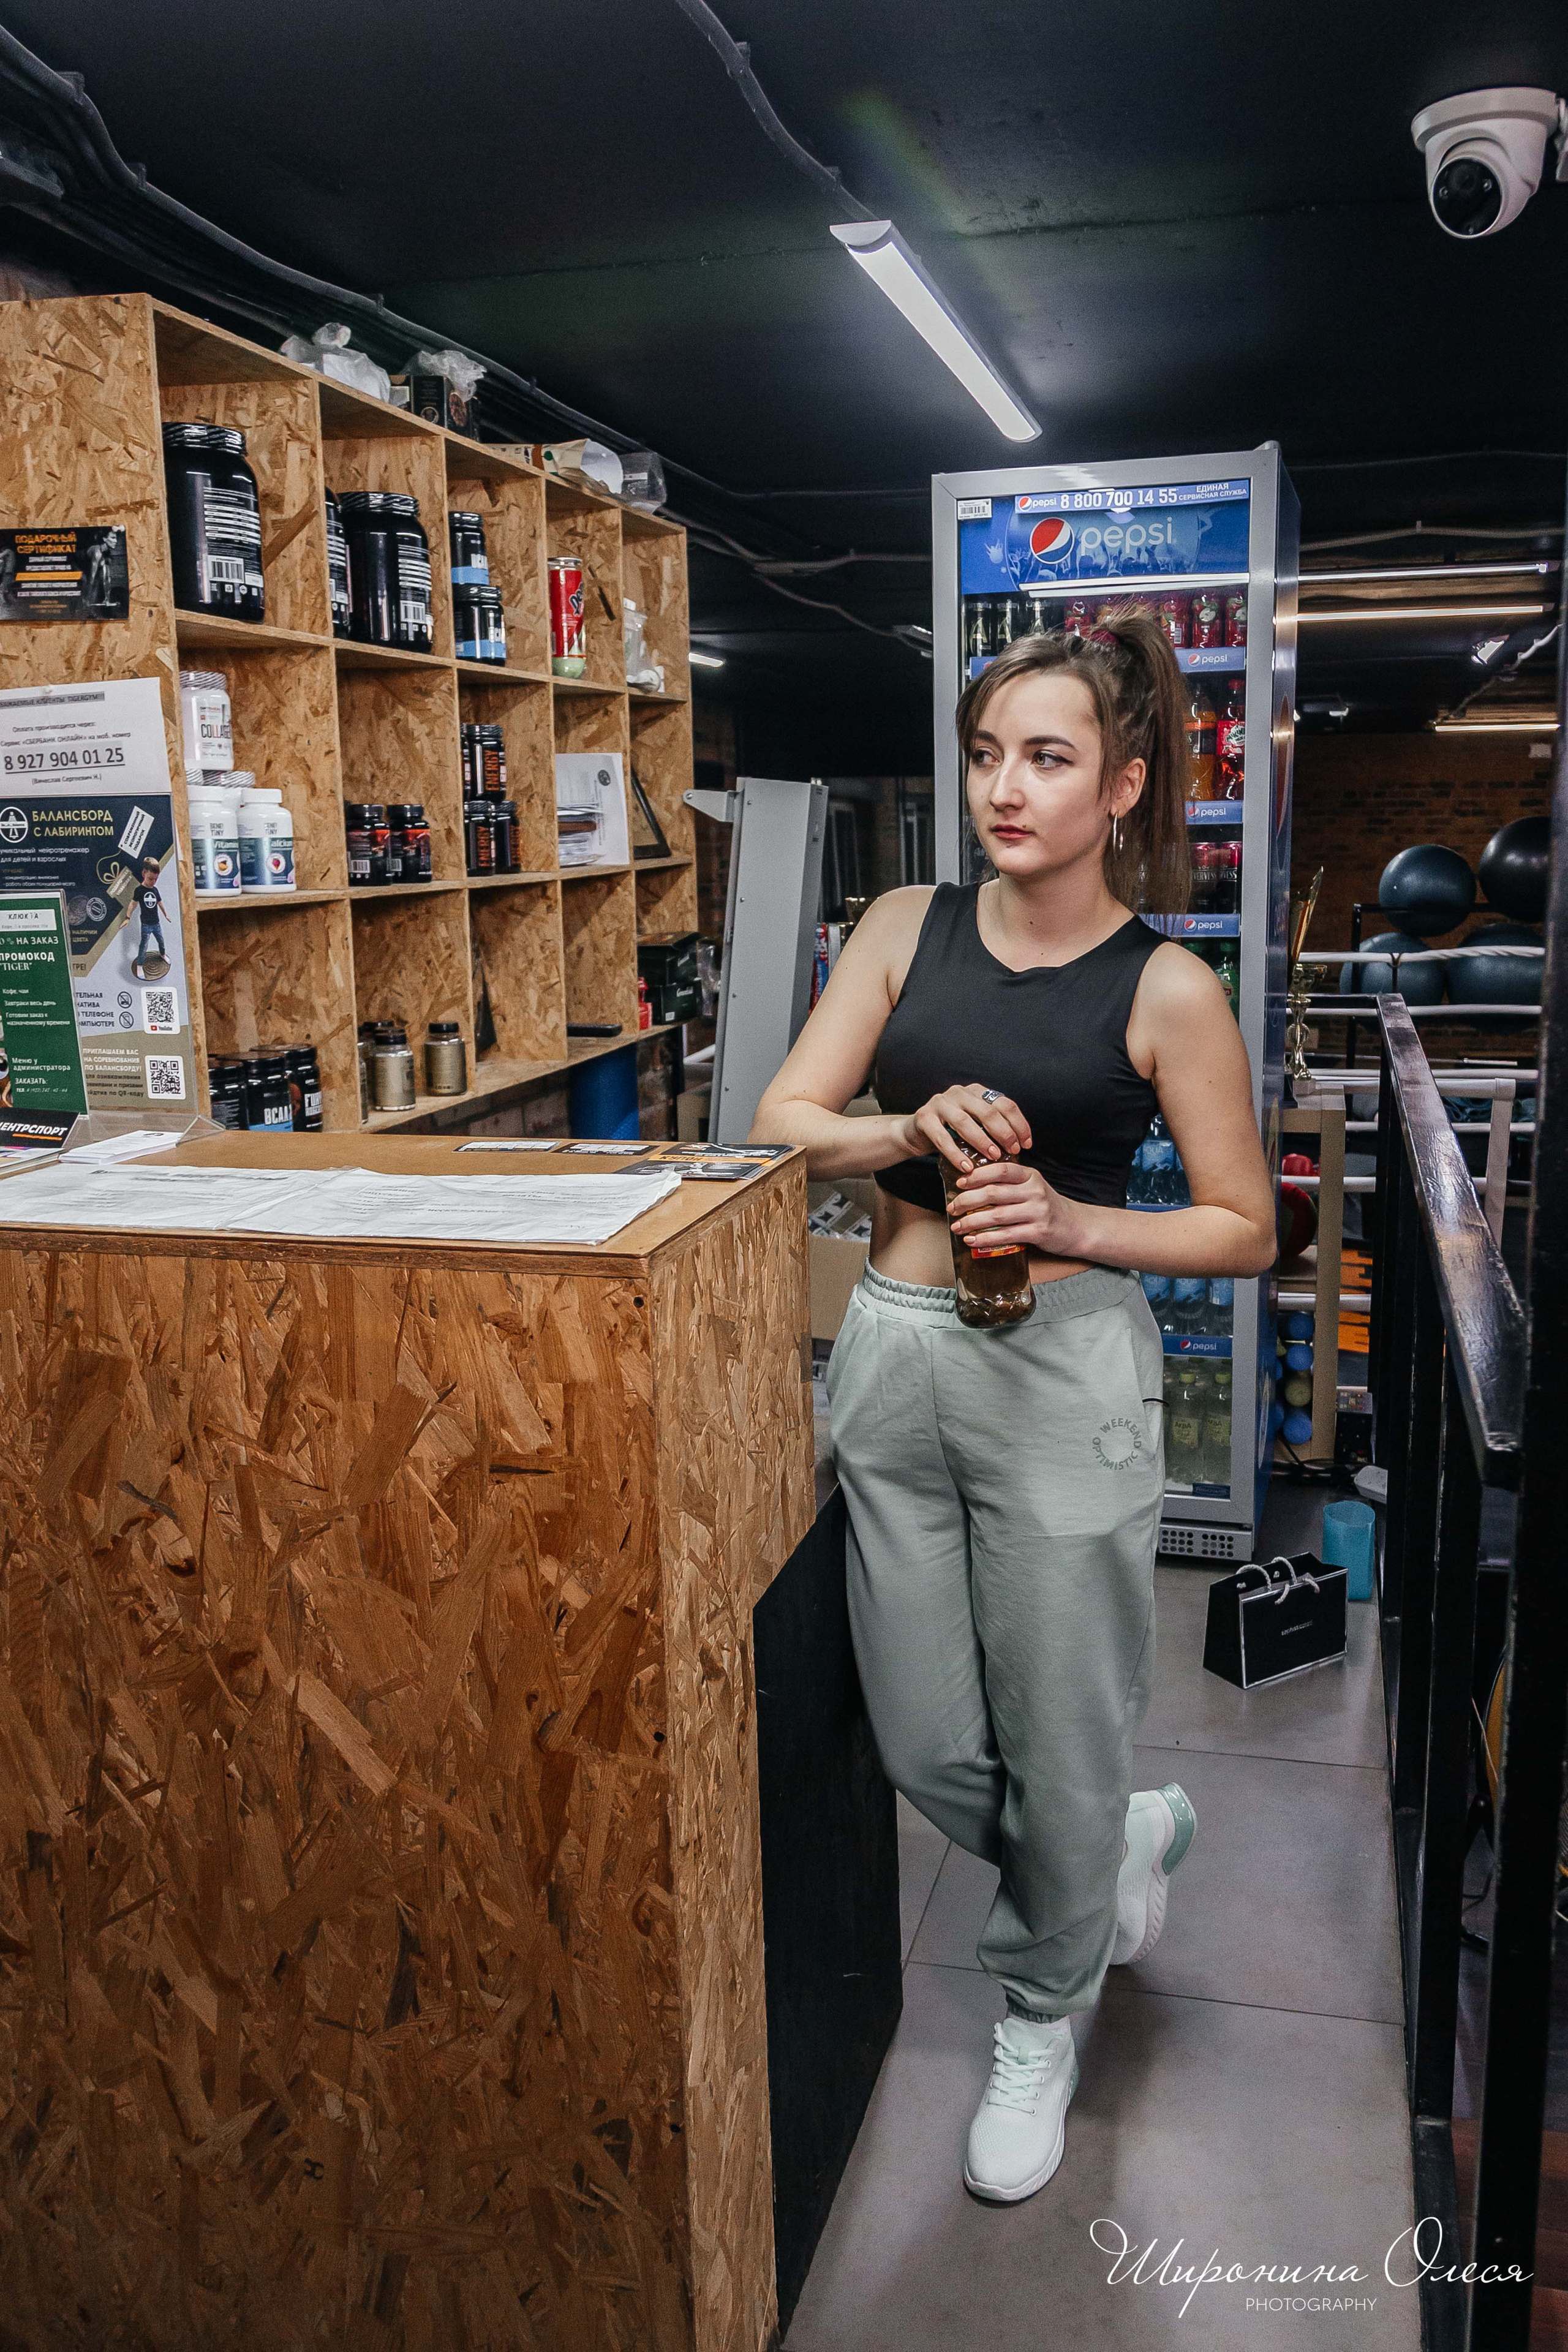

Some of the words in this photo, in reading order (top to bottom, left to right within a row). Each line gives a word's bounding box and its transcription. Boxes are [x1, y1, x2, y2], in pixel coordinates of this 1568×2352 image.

[1196, 483, 1229, 492] ЕДИНАЯ
[1033, 497, 1057, 510] pepsi
[1061, 493, 1069, 508] 8
[1074, 492, 1102, 508] 800
[1106, 490, 1133, 507] 700
[1137, 490, 1154, 504] 14
[1178, 492, 1219, 501] СЕРВИСНАЯ
[1219, 488, 1247, 497] СЛУЖБА
[15, 532, 77, 543] ПОДАРОЧНЫЙ
[1080, 516, 1174, 557] pepsi
[17, 545, 76, 554] СЕРТИФИКАТ
[1201, 654, 1227, 665] pepsi
[4, 756, 13, 770] 8
[17, 753, 43, 769] 927
[50, 751, 78, 767] 904
[83, 750, 101, 764] 01
[105, 748, 124, 762] 25
[32, 810, 113, 822] БАЛАНСБОРД
[1201, 807, 1226, 817] pepsi
[34, 827, 40, 837] С
[44, 826, 114, 837] ЛАБИРИНТОМ
[1197, 921, 1223, 930] pepsi
[0, 952, 55, 962] ПРОМОКОД
[1099, 1418, 1142, 1449] WEEKEND
[1093, 1437, 1138, 1470] OPTIMISTIC
